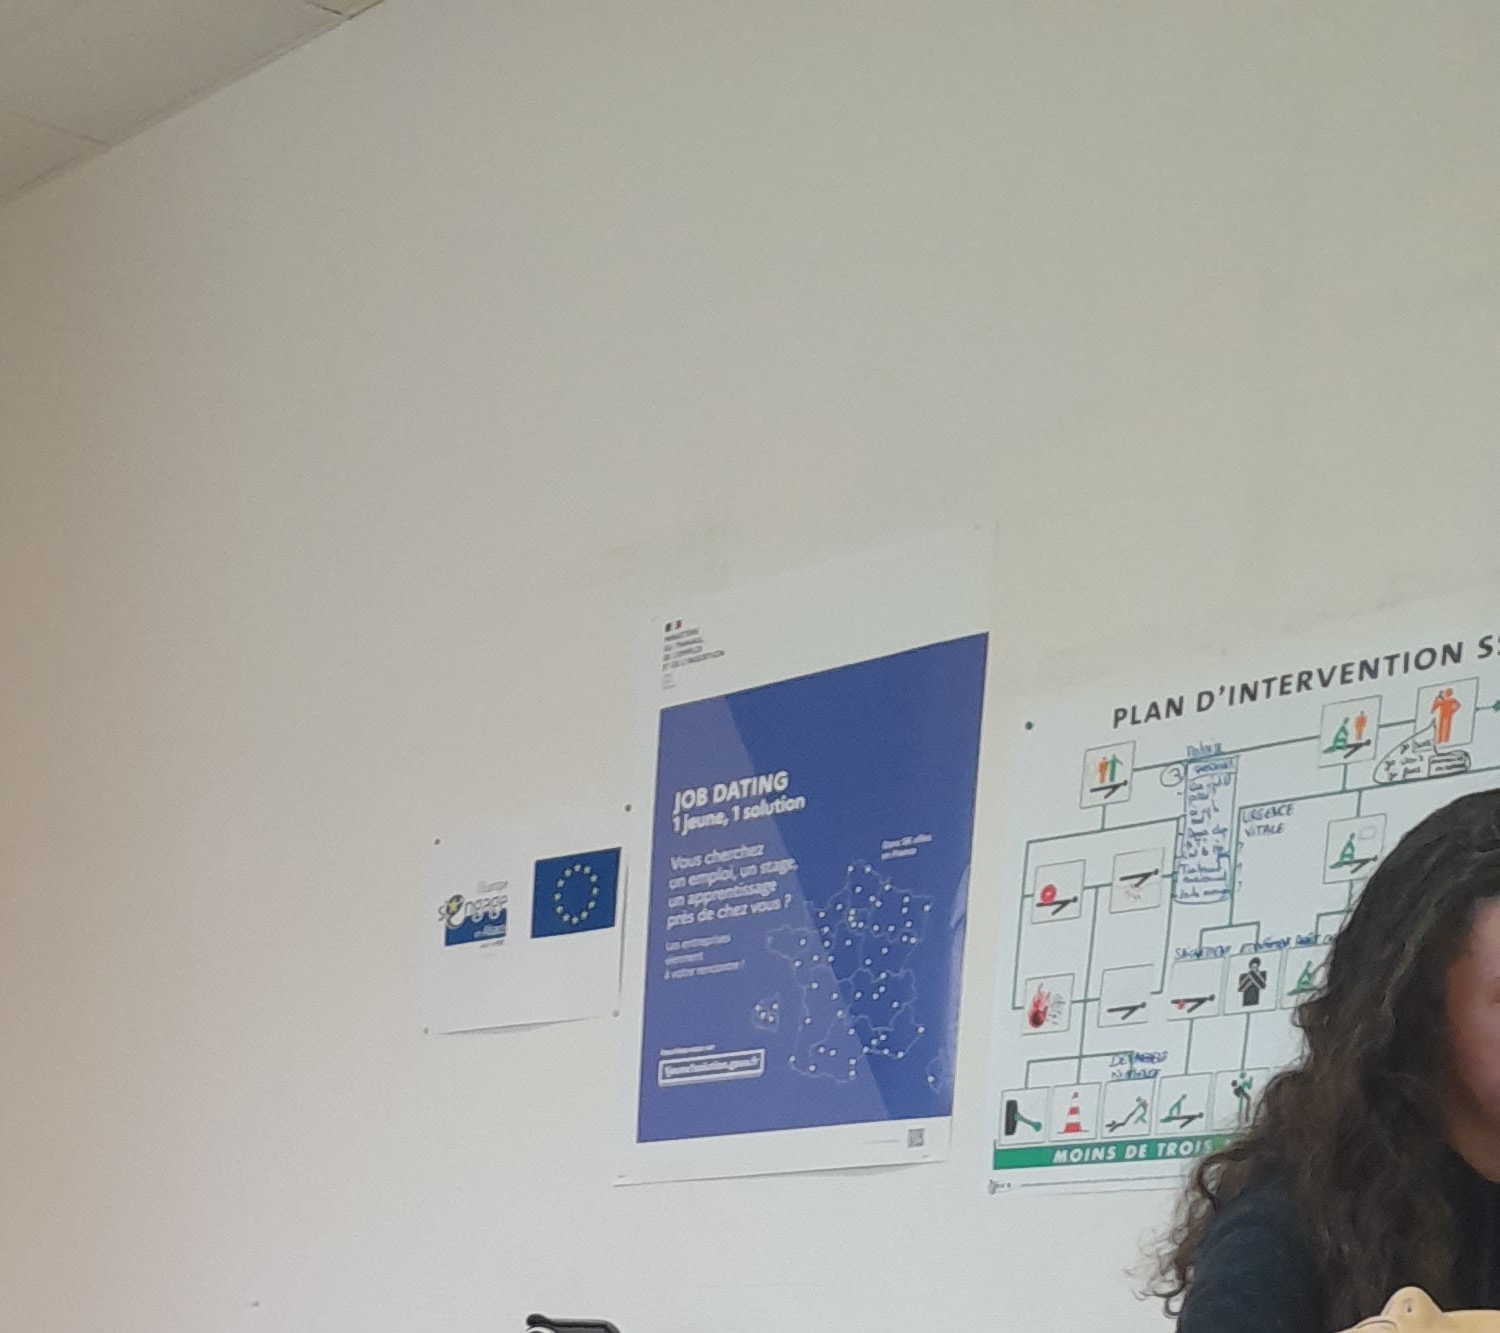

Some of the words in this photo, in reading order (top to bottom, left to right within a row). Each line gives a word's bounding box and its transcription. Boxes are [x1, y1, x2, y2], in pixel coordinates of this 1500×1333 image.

[1113, 694, 1185, 730] PLAN
[1196, 640, 1464, 713] D'INTERVENTION
[1476, 633, 1500, 660] S
[672, 786, 708, 816] JOB
[713, 770, 789, 804] DATING
[673, 816, 680, 833] 1
[681, 811, 730, 836] jeune,
[732, 805, 740, 821] 1
[743, 795, 807, 820] solution
[670, 855, 703, 870] Vous
[704, 844, 764, 865] cherchez
[668, 876, 686, 890] un
[740, 864, 758, 878] un
[668, 895, 685, 908] un
[687, 880, 777, 908] apprentissage
[666, 909, 695, 931] près
[697, 907, 716, 922] de
[717, 903, 749, 919] chez
[751, 898, 781, 914] vous
[784, 893, 792, 909] ?
[1053, 1146, 1117, 1164] MOINS
[1124, 1144, 1147, 1160] DE
[1157, 1139, 1212, 1157] TROIS
